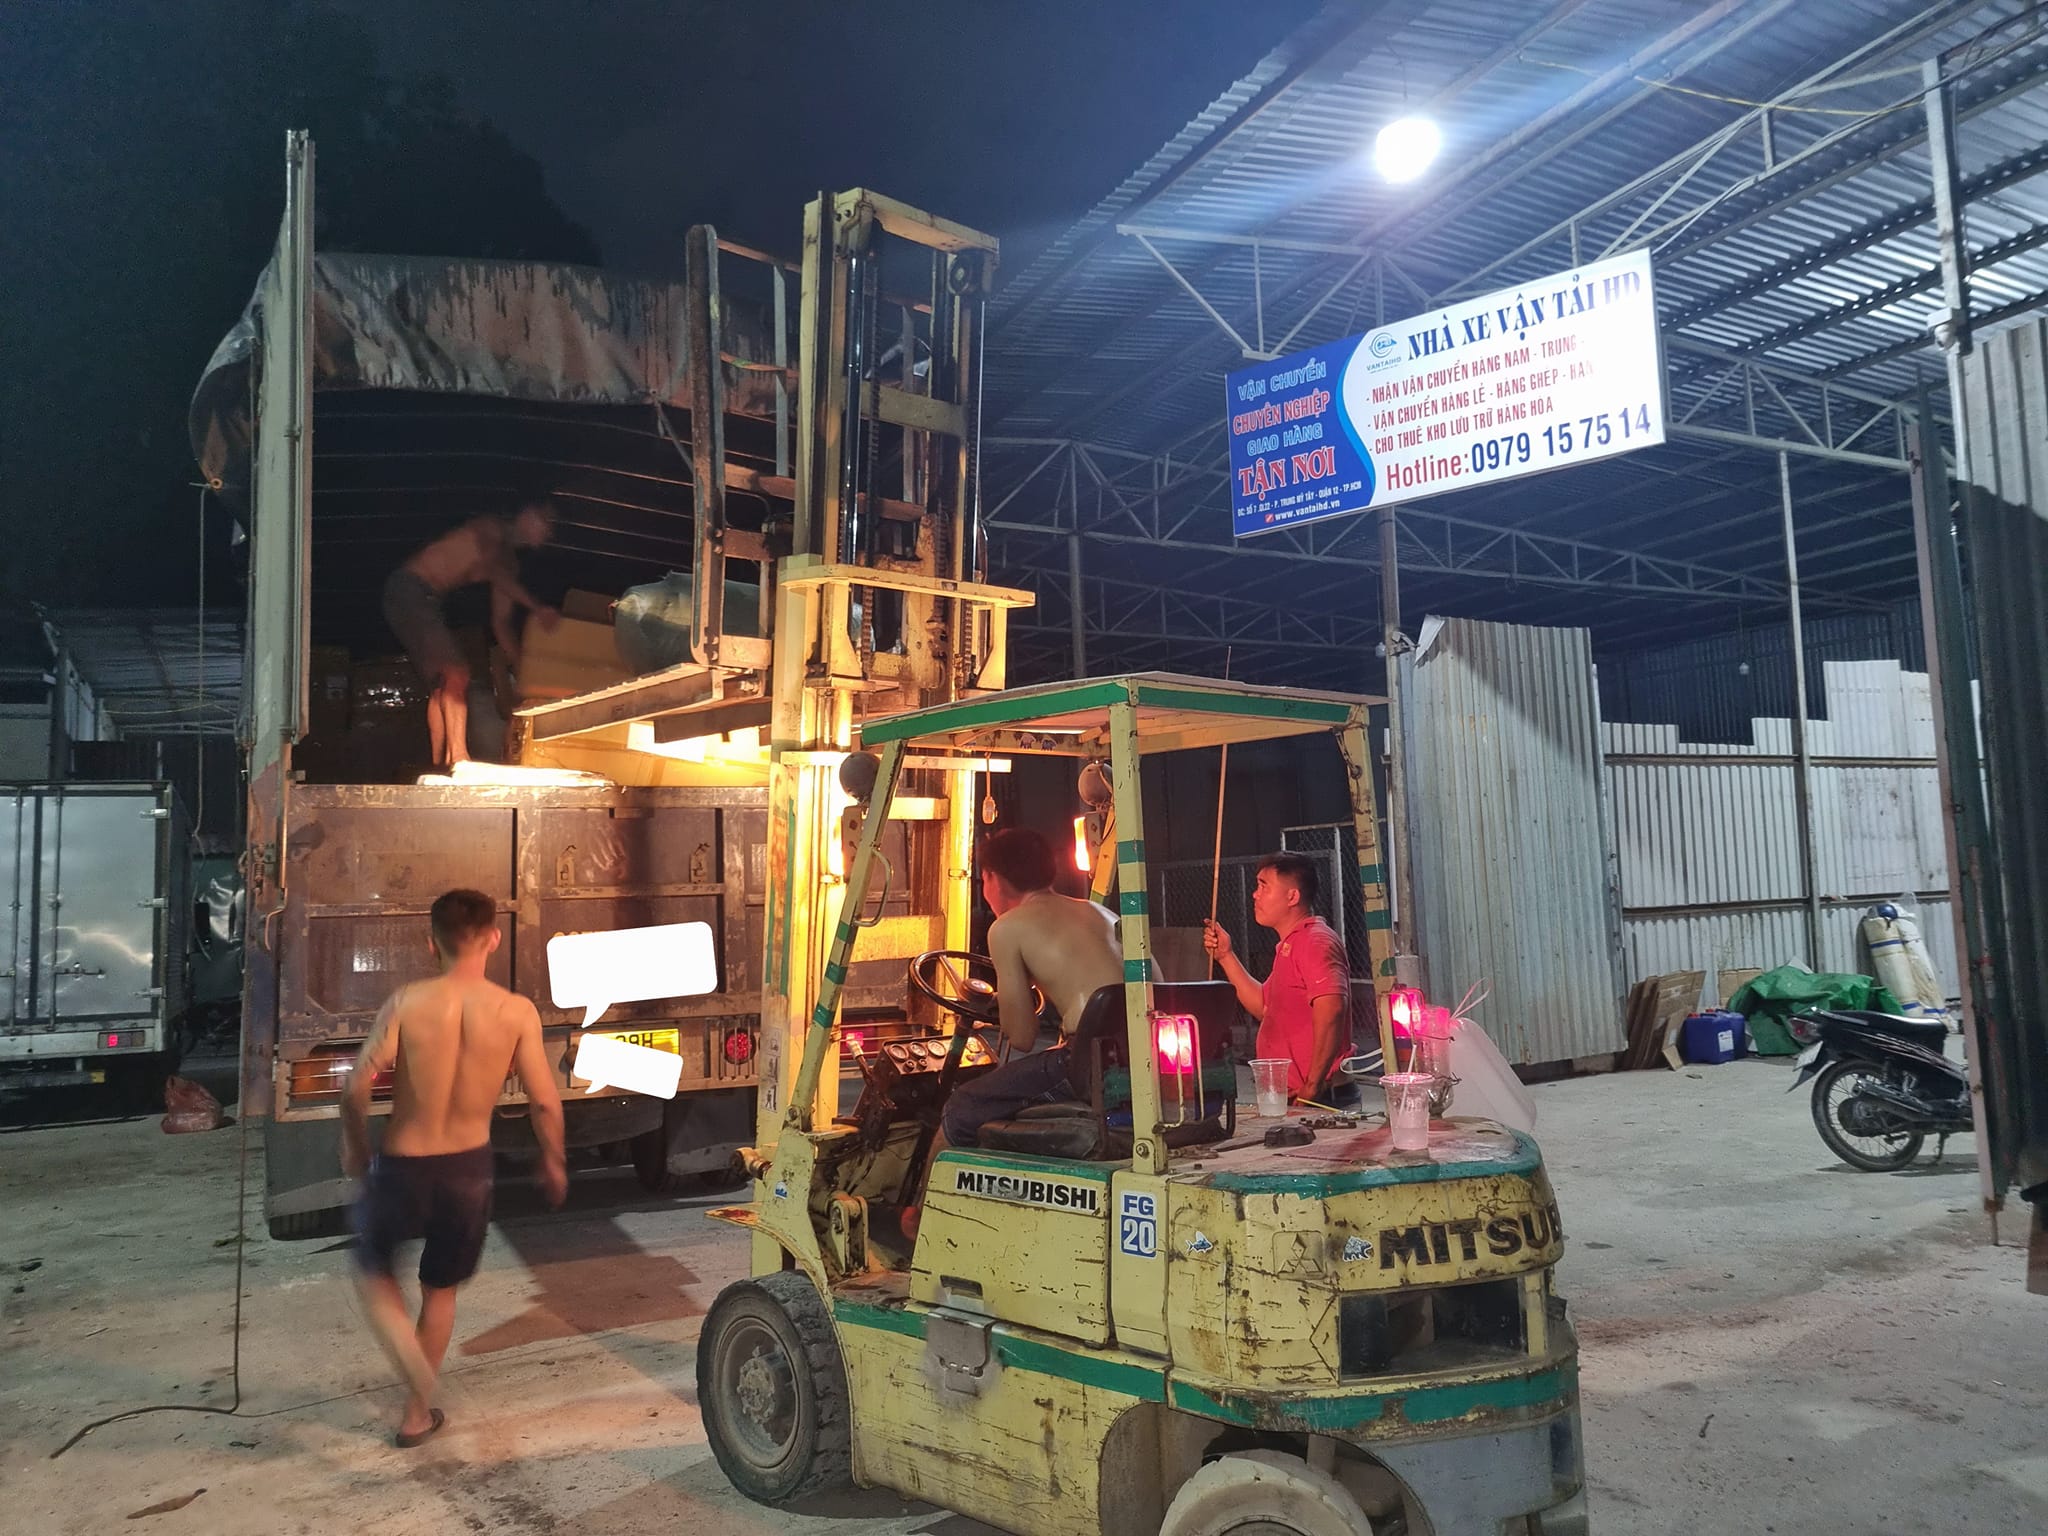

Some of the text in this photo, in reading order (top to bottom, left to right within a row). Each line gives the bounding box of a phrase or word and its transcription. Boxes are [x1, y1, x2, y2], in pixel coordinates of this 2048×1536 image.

[1408, 271, 1640, 361] NHÀ XE VẬN TẢI HD
[1238, 357, 1326, 402] VẬN CHUYỂN
[1372, 381, 1399, 404] NHẬN
[1402, 374, 1424, 398] VẬN
[1427, 360, 1469, 389] CHUYỂN
[1472, 355, 1501, 377] HÀNG
[1504, 347, 1530, 369] NAM
[1541, 334, 1577, 359] TRUNG
[1233, 387, 1331, 436] CHUYÊN NGHIỆP
[1373, 409, 1394, 432] VẬN
[1398, 394, 1438, 424] CHUYỂN
[1441, 391, 1469, 413] HÀNG
[1496, 377, 1526, 399] HÀNG
[1530, 367, 1559, 391] GHÉP
[1247, 422, 1323, 457] GIAO HÀNG
[1375, 435, 1394, 455] CHO
[1397, 425, 1423, 449] THUÊ
[1427, 422, 1447, 442] KHO
[1450, 415, 1469, 436] LƯU
[1473, 407, 1493, 431] TRỮ
[1497, 403, 1527, 424] HÀNG
[1238, 446, 1336, 501] TẬN NƠI
[1275, 499, 1340, 520] www.vantaihd.vn
[956, 1170, 1097, 1212] MITSUBISHI
[1124, 1194, 1154, 1216] FG
[1123, 1218, 1155, 1254] 20
